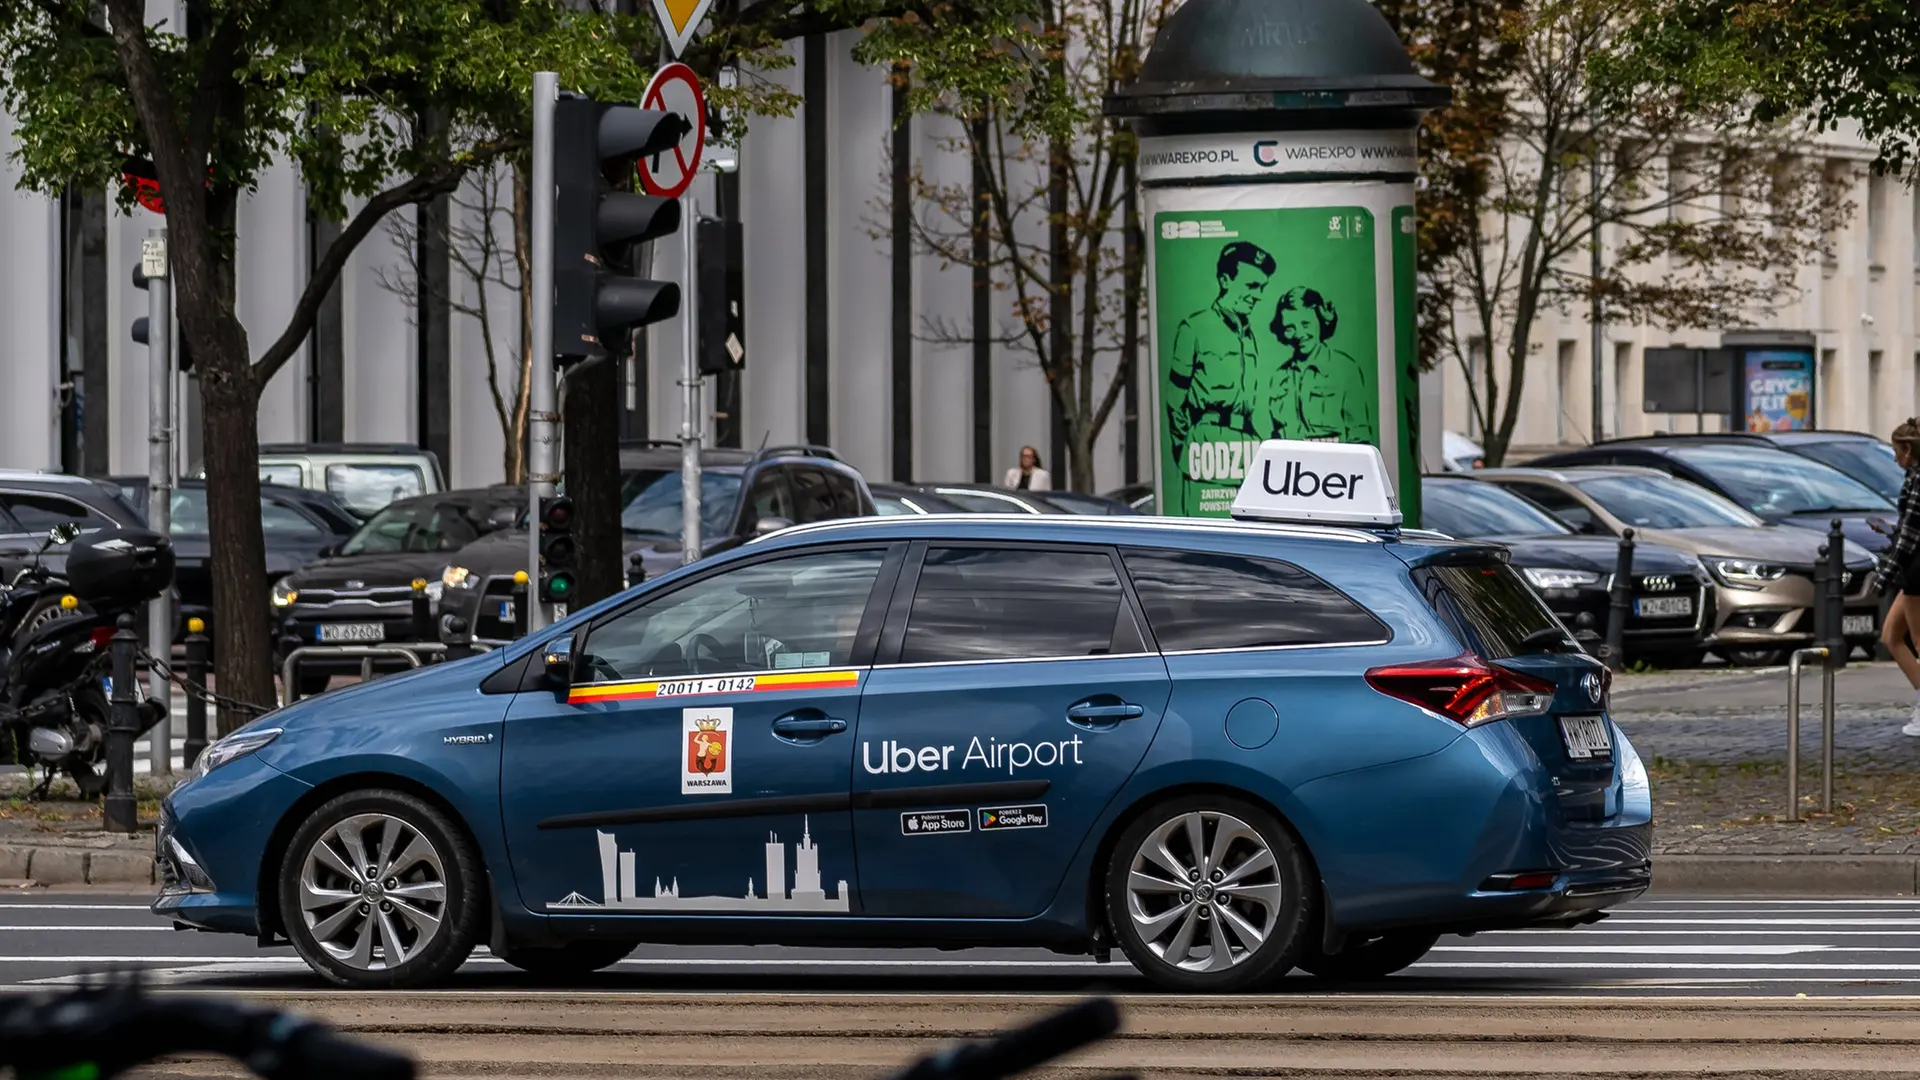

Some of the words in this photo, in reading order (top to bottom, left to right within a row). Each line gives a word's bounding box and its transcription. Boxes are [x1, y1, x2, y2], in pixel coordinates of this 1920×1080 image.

[1285, 146, 1356, 159] WAREXPO
[1262, 459, 1363, 500] Uber
[443, 735, 486, 745] HYBRID
[862, 740, 955, 775] Uber
[961, 733, 1084, 776] Airport
[686, 779, 728, 788] WARSZAWA
[921, 820, 940, 831] App
[941, 819, 965, 829] Store
[998, 814, 1027, 826] Google
[1027, 813, 1043, 825] Play
